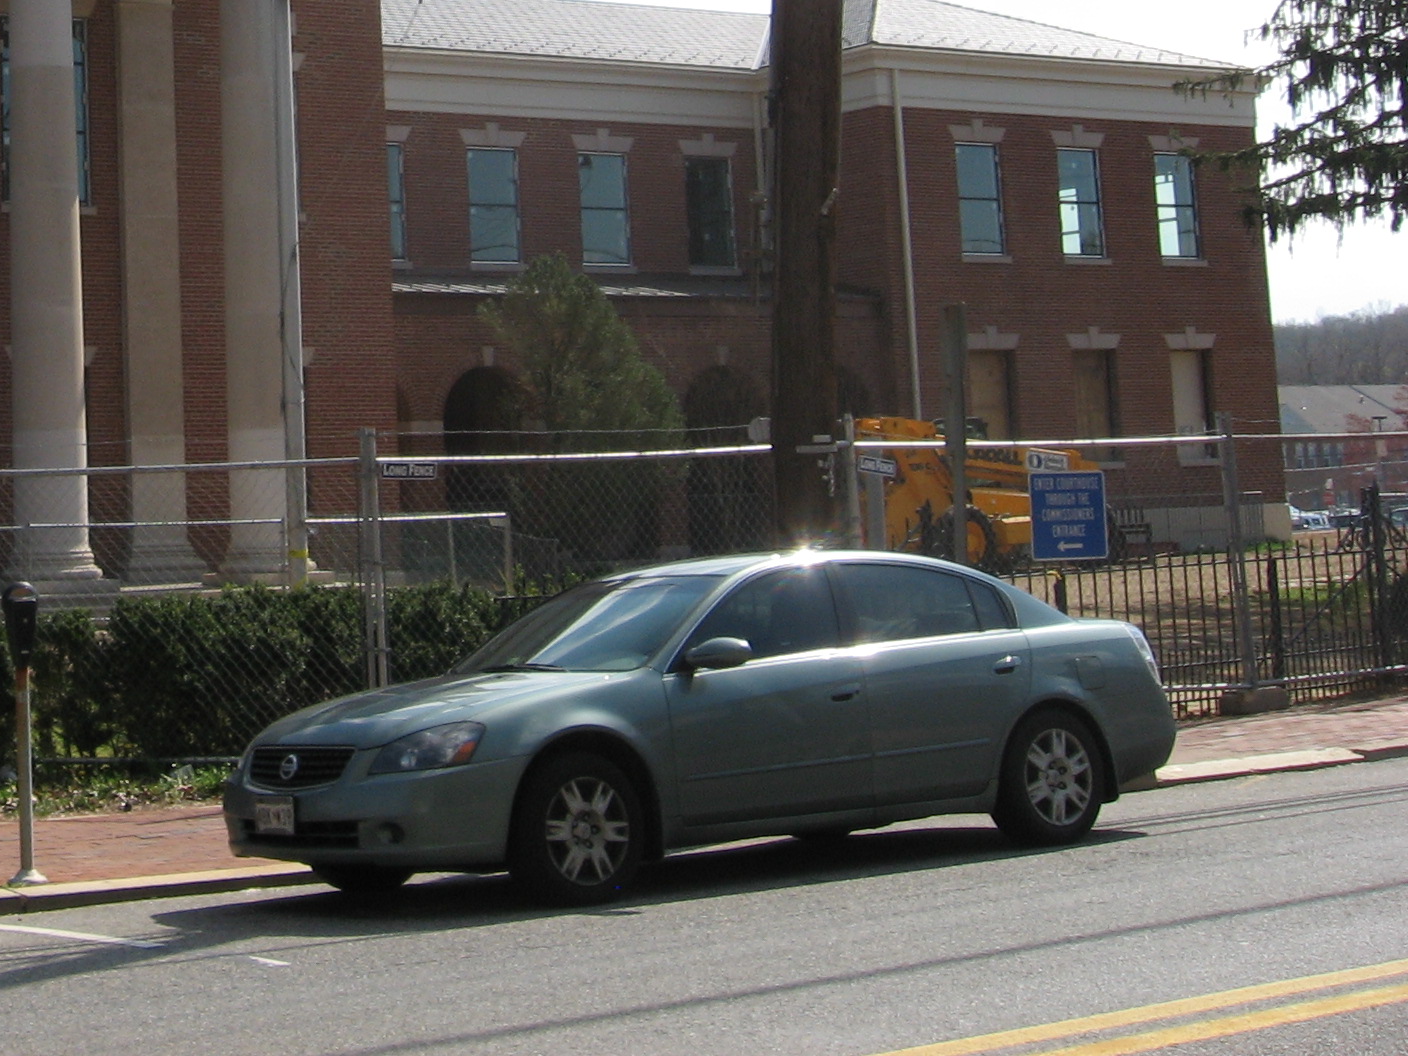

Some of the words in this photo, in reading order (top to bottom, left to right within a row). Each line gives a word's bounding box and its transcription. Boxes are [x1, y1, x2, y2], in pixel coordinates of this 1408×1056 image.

[383, 464, 407, 476] LONG
[409, 464, 434, 476] FENCE
[1052, 524, 1086, 537] ENTRANCE
